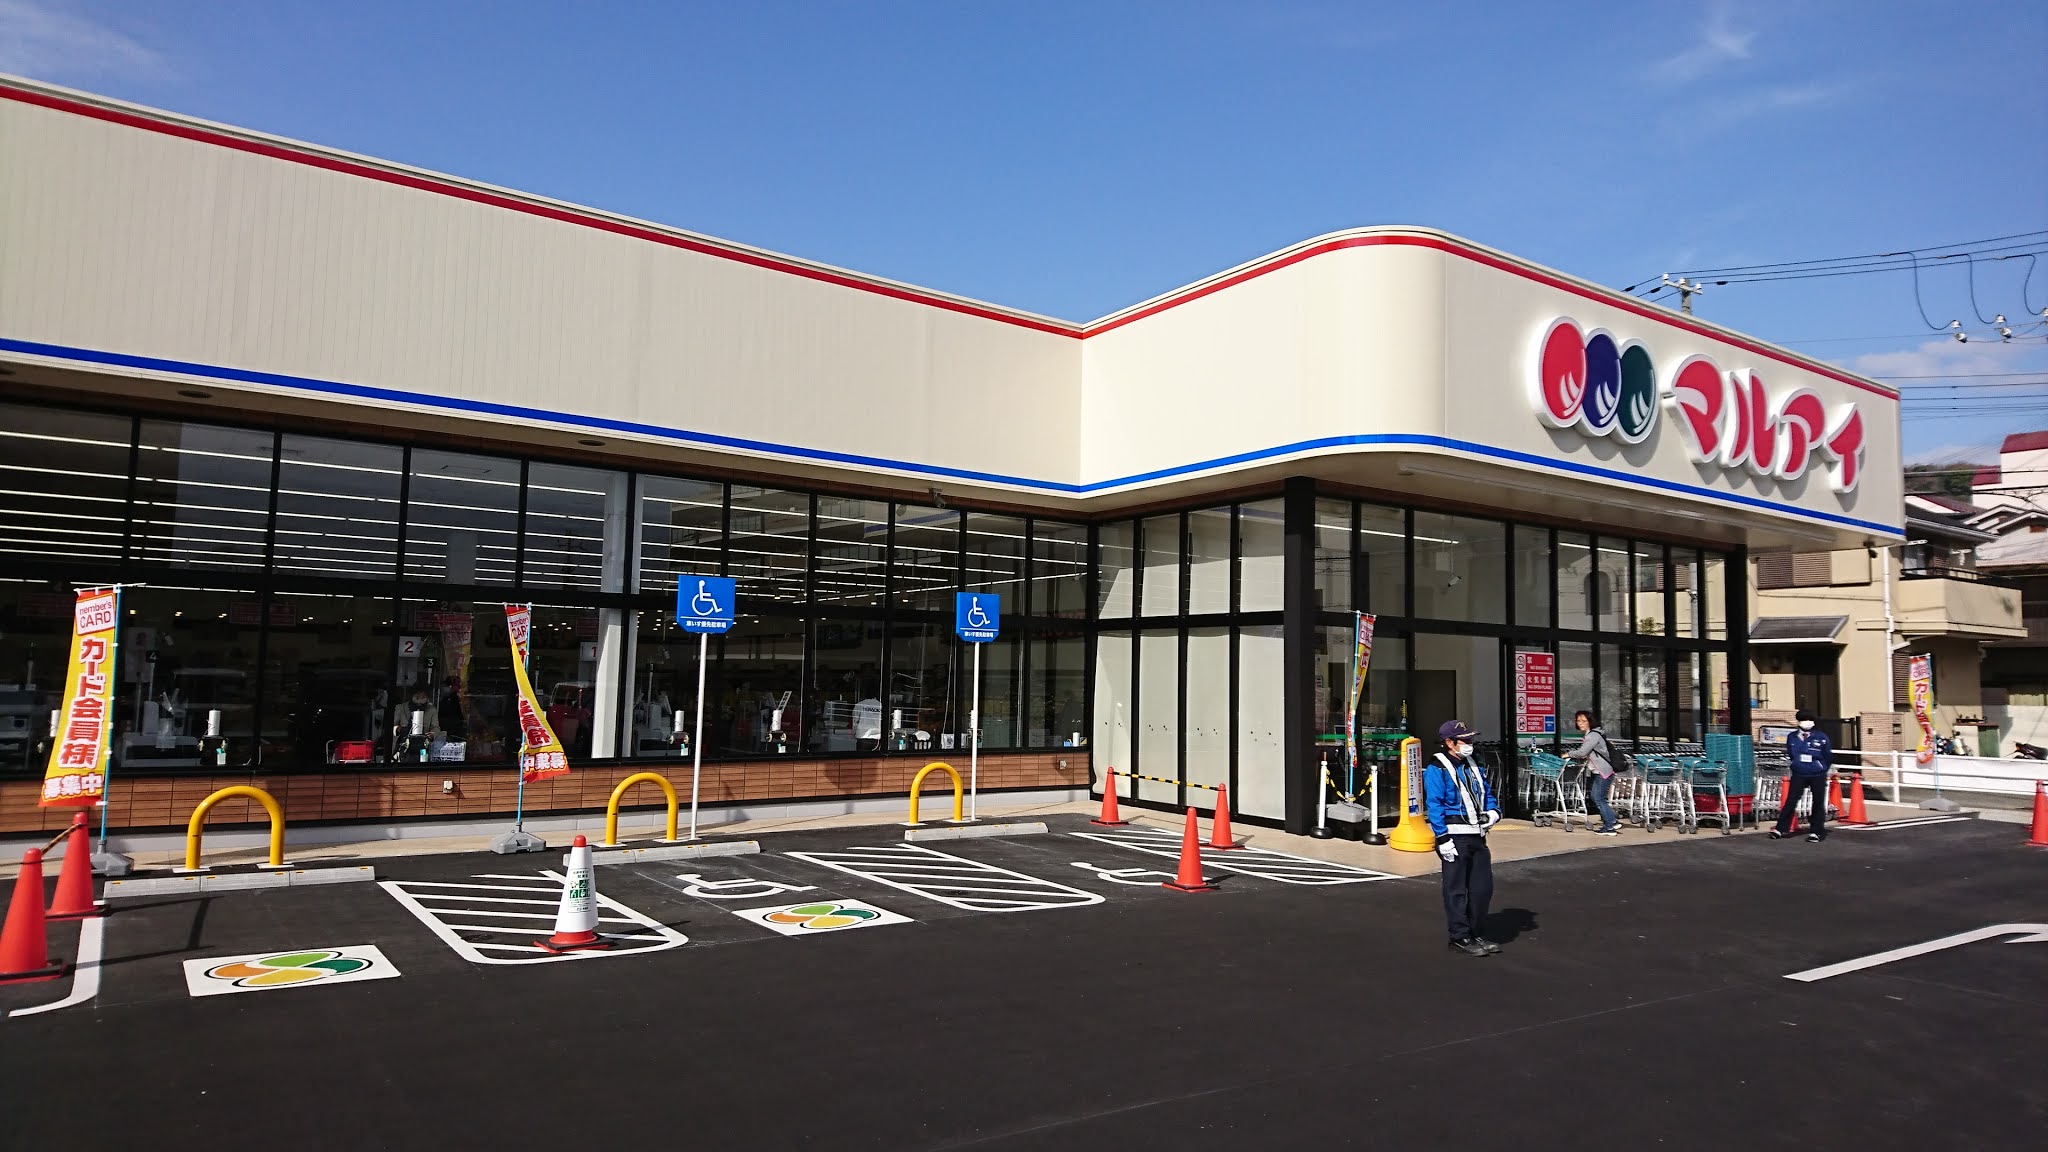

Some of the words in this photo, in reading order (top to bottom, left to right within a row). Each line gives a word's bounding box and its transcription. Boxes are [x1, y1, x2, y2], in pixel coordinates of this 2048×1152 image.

[1670, 354, 1866, 493] マルアイ
[79, 610, 112, 629] CARD
[511, 625, 528, 640] CAR
[404, 640, 414, 653] 2
[591, 646, 597, 658] 1
[149, 651, 158, 661] 4
[427, 658, 434, 667] 3
[60, 638, 105, 767] カード会員様
[43, 772, 103, 799] 募集中
